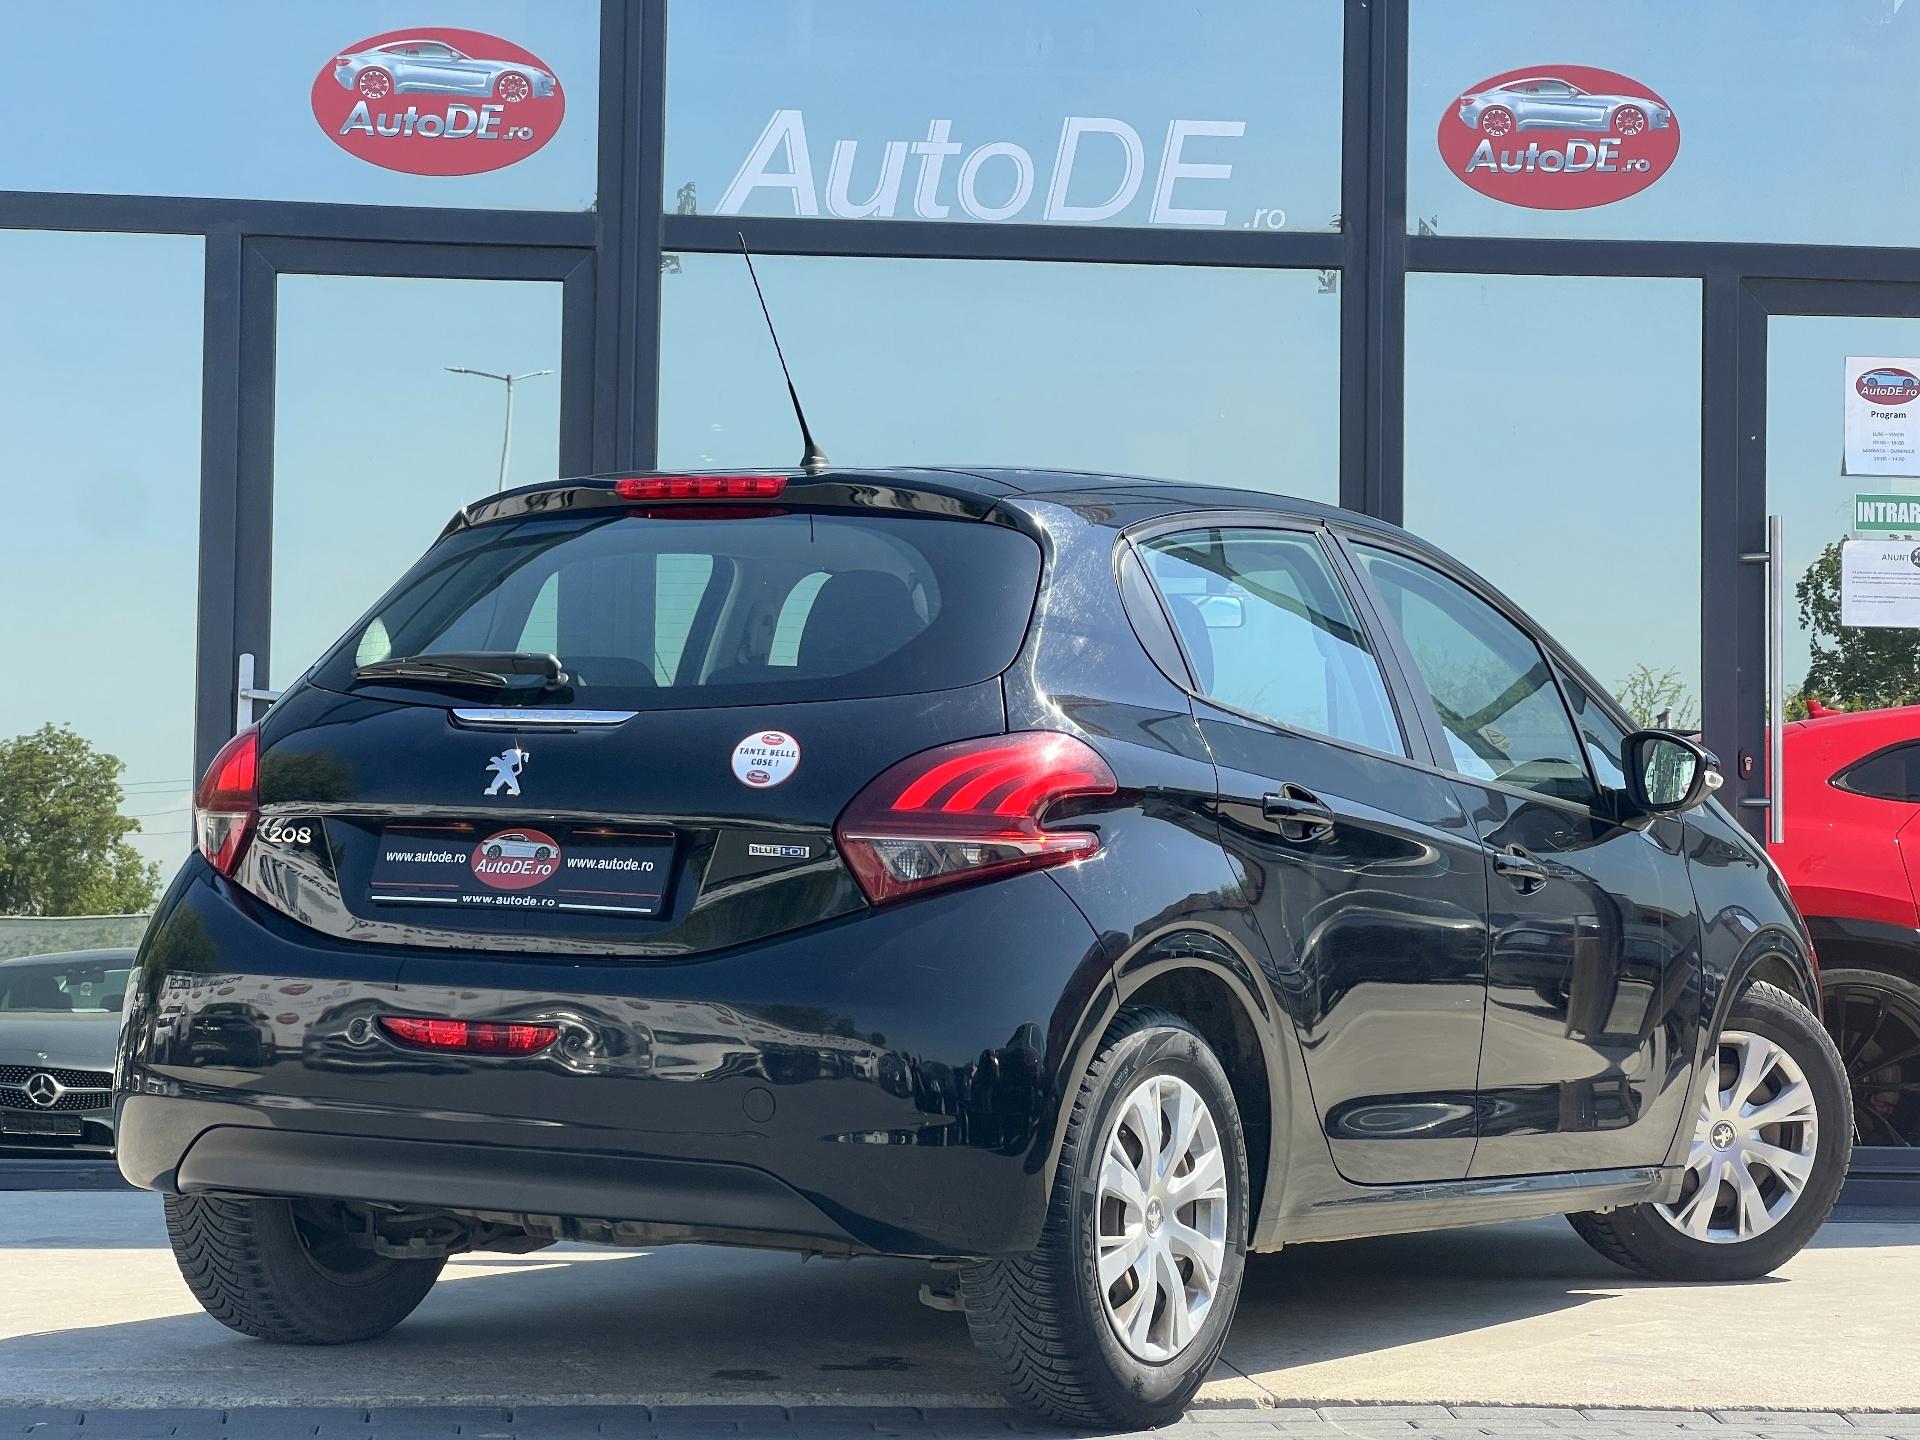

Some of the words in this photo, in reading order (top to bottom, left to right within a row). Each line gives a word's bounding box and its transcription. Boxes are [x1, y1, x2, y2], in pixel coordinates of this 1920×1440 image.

[1870, 410, 1907, 420] Program
[1857, 501, 1920, 523] INTRAR
[740, 747, 767, 756] TANTE
[770, 749, 797, 758] BELLE
[751, 758, 773, 767] COSE
[268, 826, 312, 844] 208
[386, 850, 467, 864] www.autode.ro
[474, 858, 552, 876] AutoDE.ro
[567, 857, 654, 872] www.autode.ro
[462, 895, 555, 907] www.autode.ro
